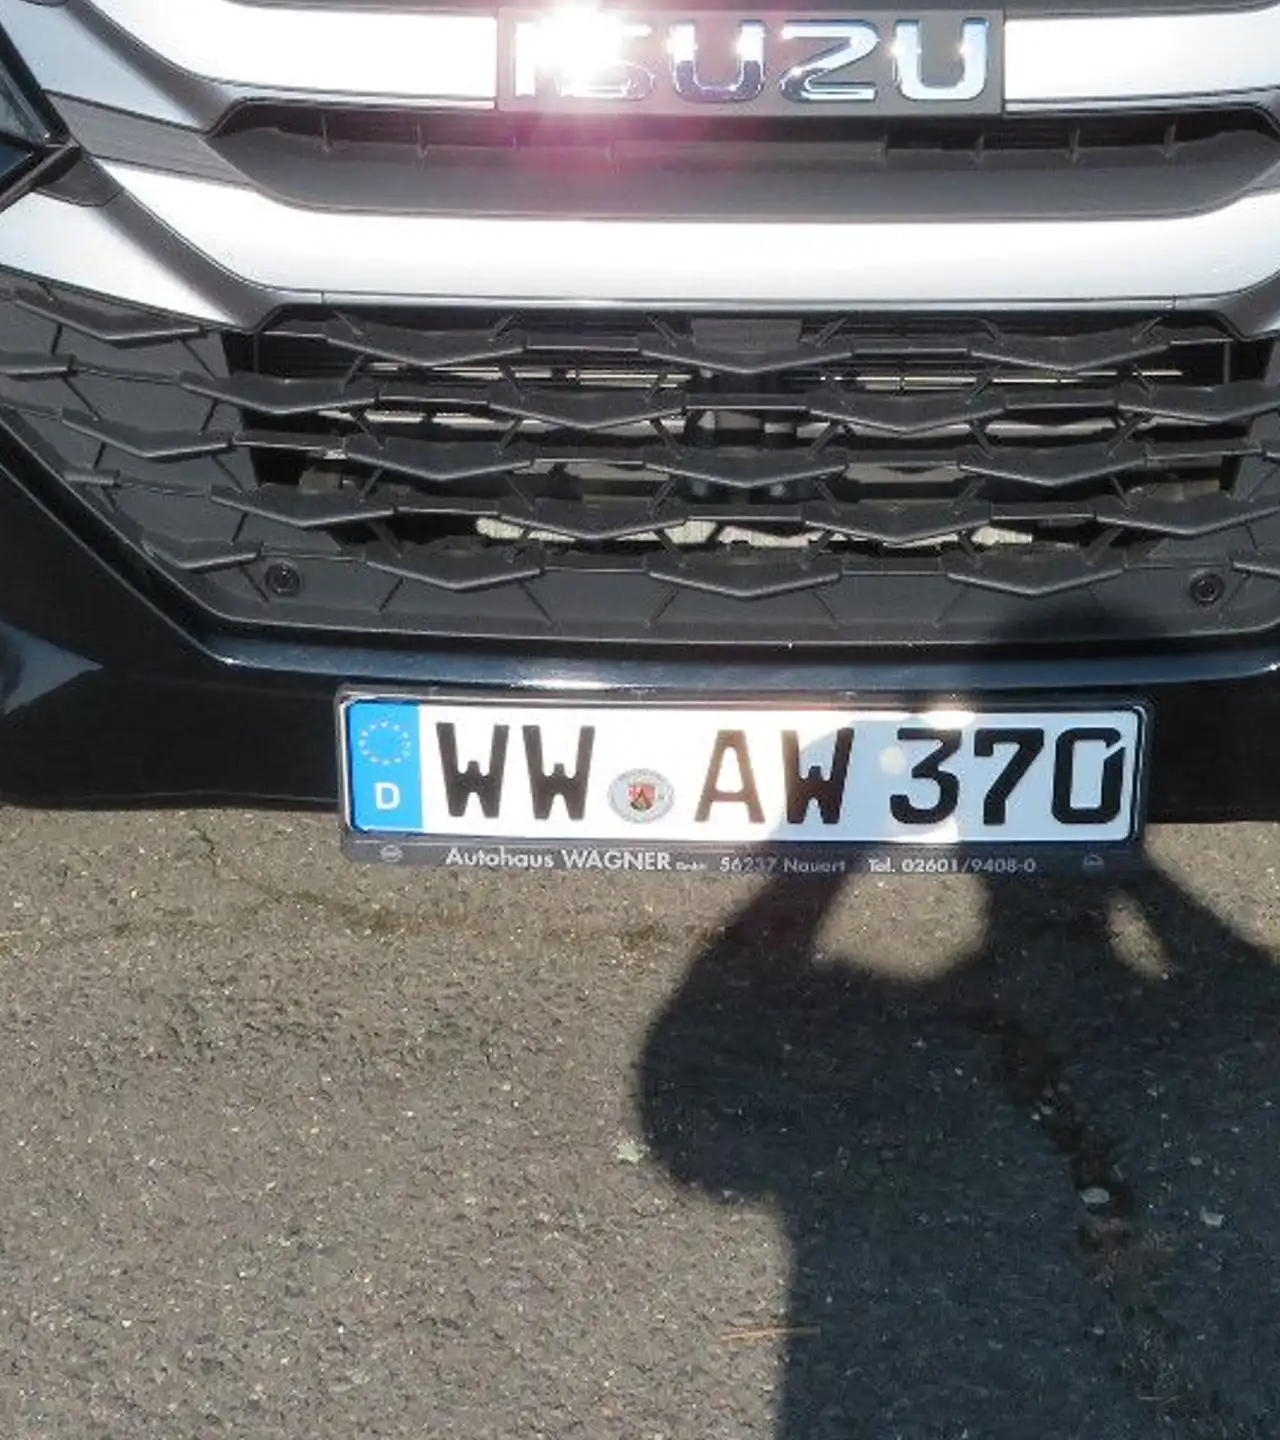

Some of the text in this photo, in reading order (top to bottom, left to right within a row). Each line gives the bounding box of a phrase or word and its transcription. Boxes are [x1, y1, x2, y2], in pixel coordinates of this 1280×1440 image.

[435, 721, 1126, 826] WW AW 370
[374, 782, 401, 811] D
[444, 846, 555, 868] Autohaus
[560, 848, 671, 870] WAGNER
[719, 857, 777, 873] 56237
[868, 857, 896, 873] Tel.
[901, 857, 1037, 874] 02601/9408-0
